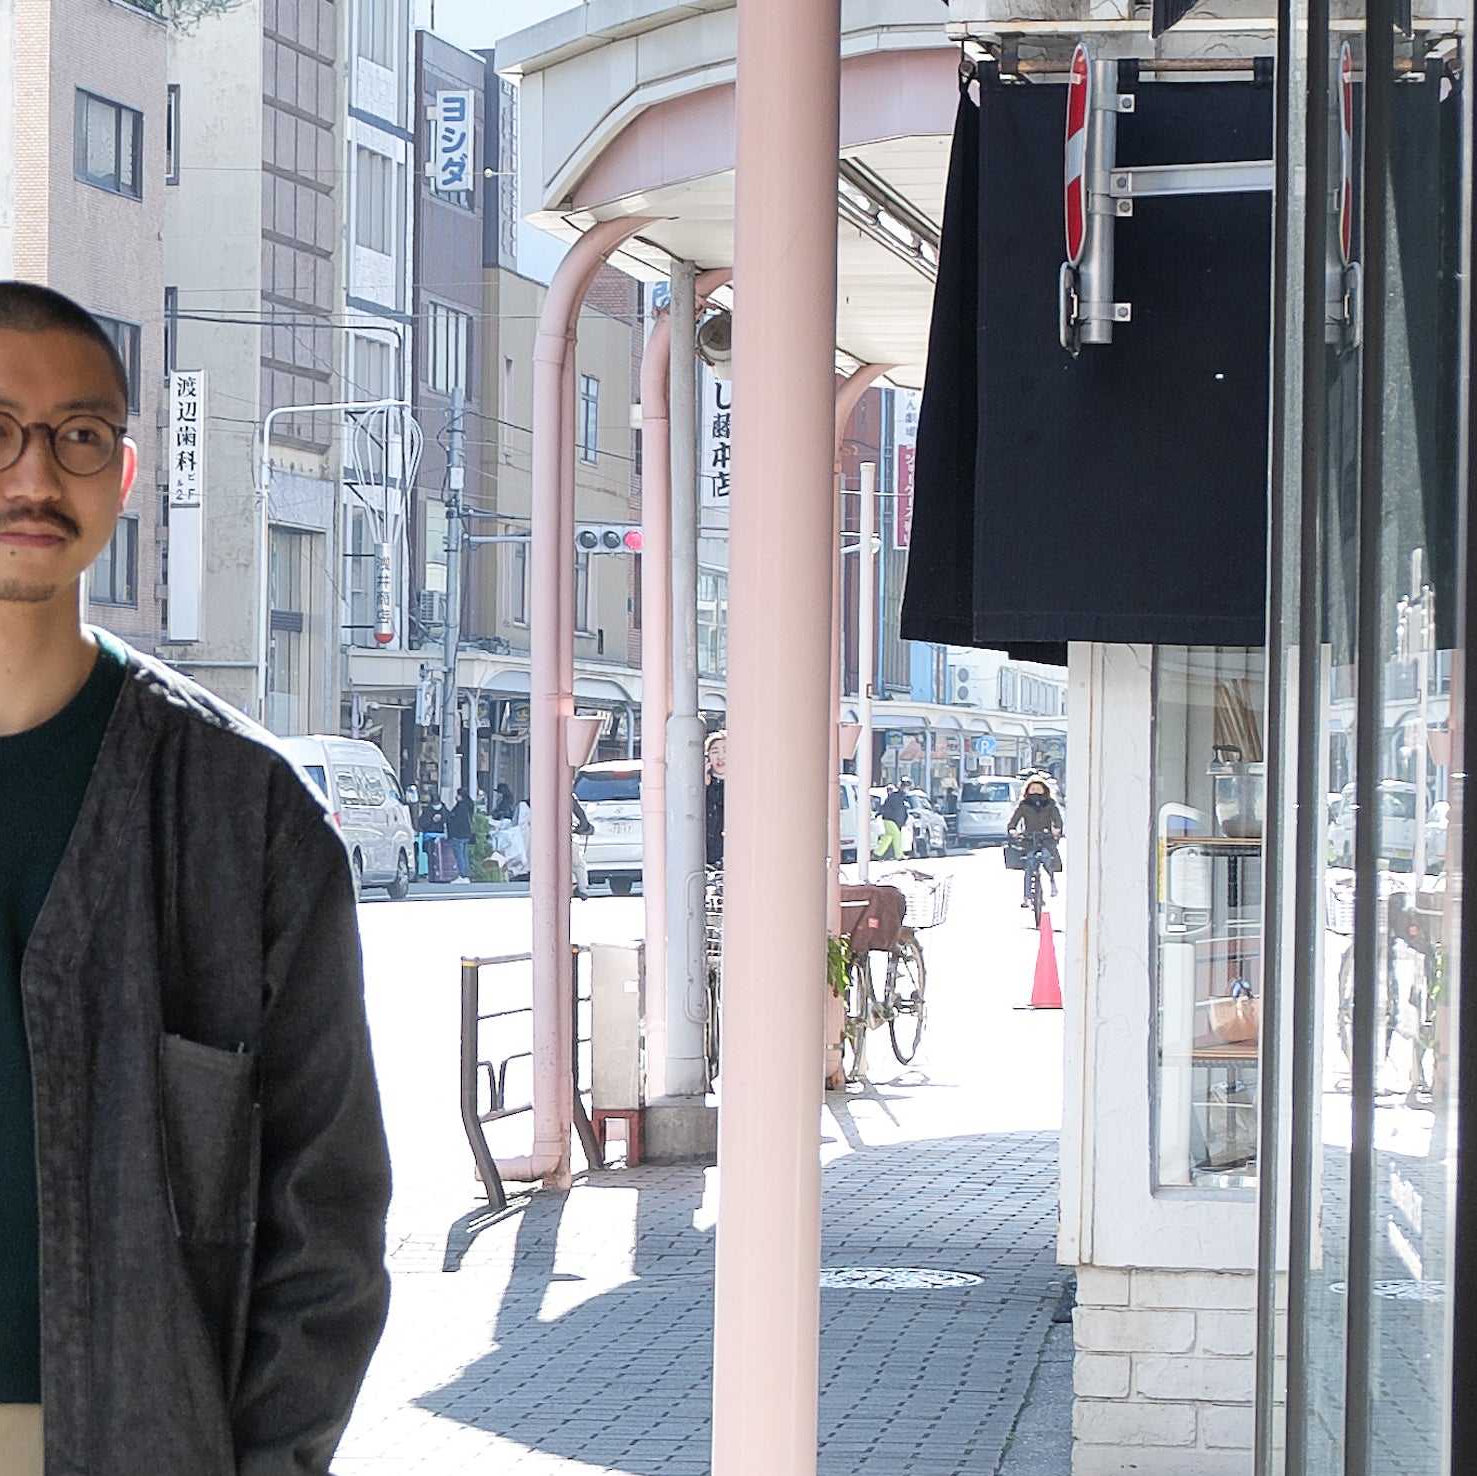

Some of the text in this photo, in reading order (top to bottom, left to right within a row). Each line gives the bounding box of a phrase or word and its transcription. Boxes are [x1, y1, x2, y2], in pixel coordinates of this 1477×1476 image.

[442, 97, 468, 185] ヨシダ
[176, 376, 197, 471] 渡辺歯科
